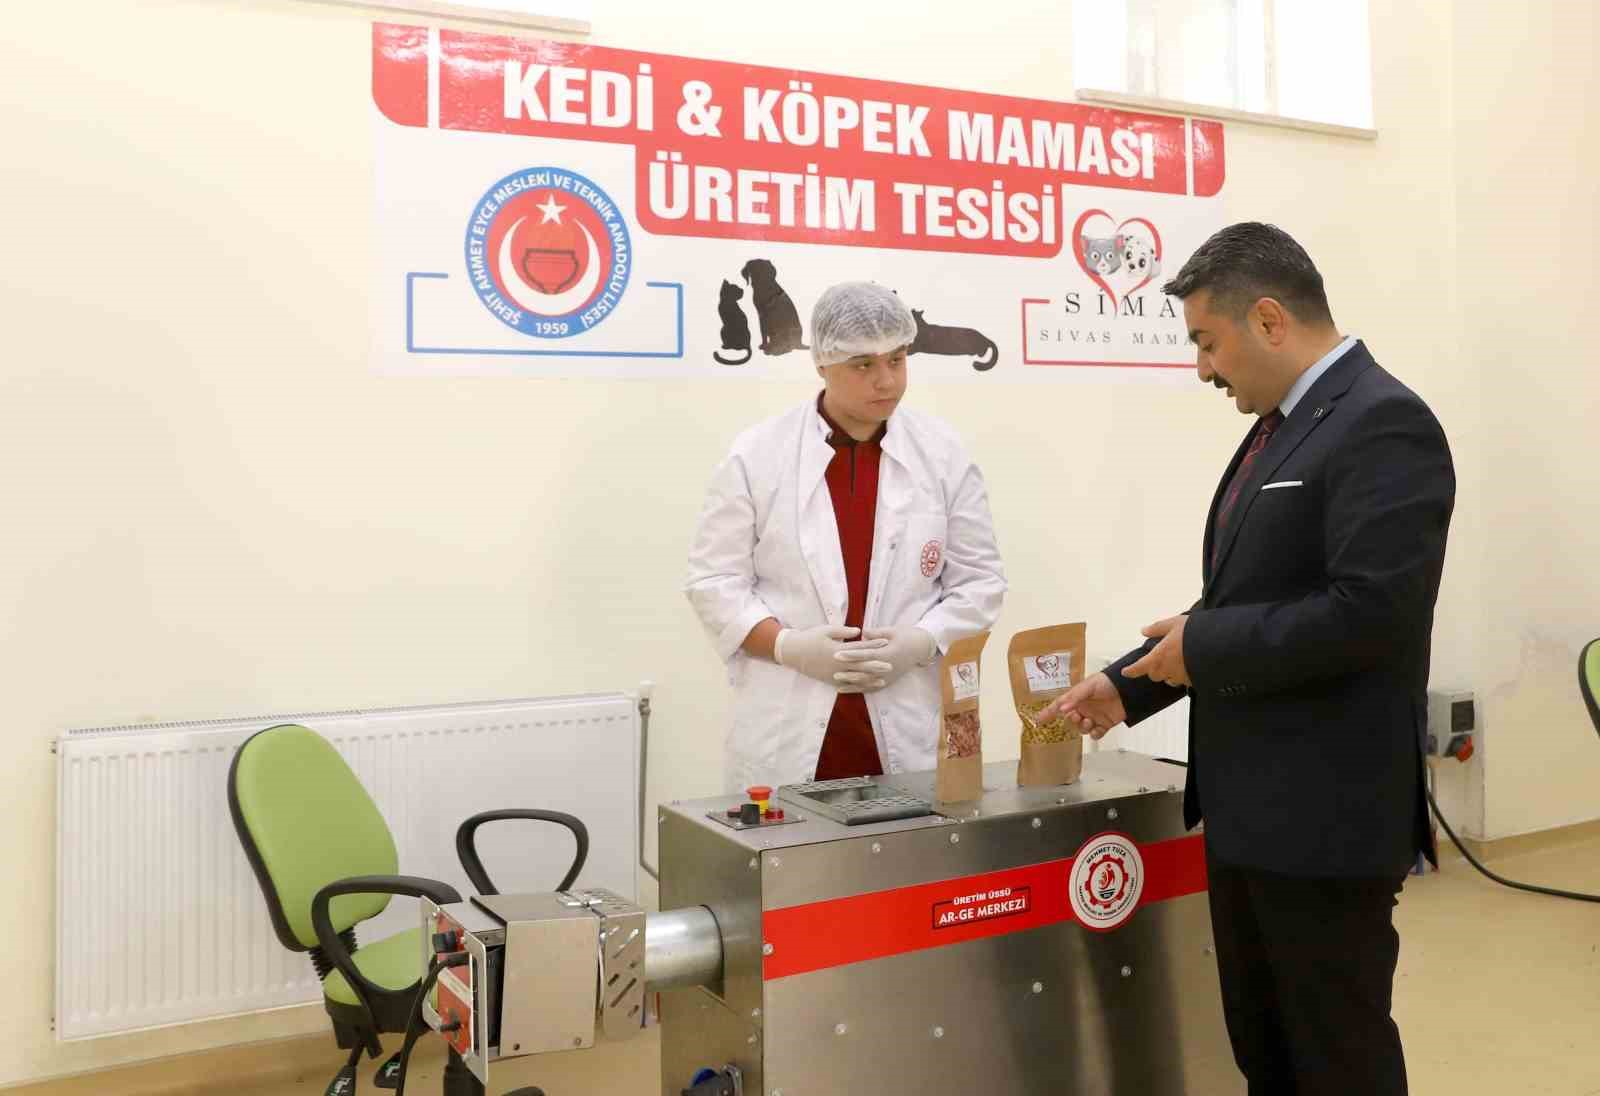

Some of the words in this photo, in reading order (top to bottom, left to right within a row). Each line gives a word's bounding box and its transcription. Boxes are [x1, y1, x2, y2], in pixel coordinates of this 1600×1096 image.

[503, 61, 654, 131] KEDİ
[677, 80, 723, 138] &
[744, 80, 932, 158] KÖPEK
[948, 109, 1155, 180] MAMASI
[494, 170, 550, 204] MESLEKİ
[553, 174, 573, 190] VE
[649, 150, 875, 232] ÜRETİM
[894, 180, 1056, 244] TESİSİ
[472, 200, 498, 235] EYCE
[573, 180, 616, 222] TEKNİK
[470, 238, 492, 290] AHMET
[607, 222, 627, 293] ANADOLU
[1065, 288, 1177, 318] SİMA
[536, 323, 569, 335] 1959
[1086, 846, 1110, 864] MEHMET
[939, 908, 975, 925] AR-GE
[976, 896, 1025, 918] MERKEZİ
[953, 892, 986, 906] ÜRETİM
